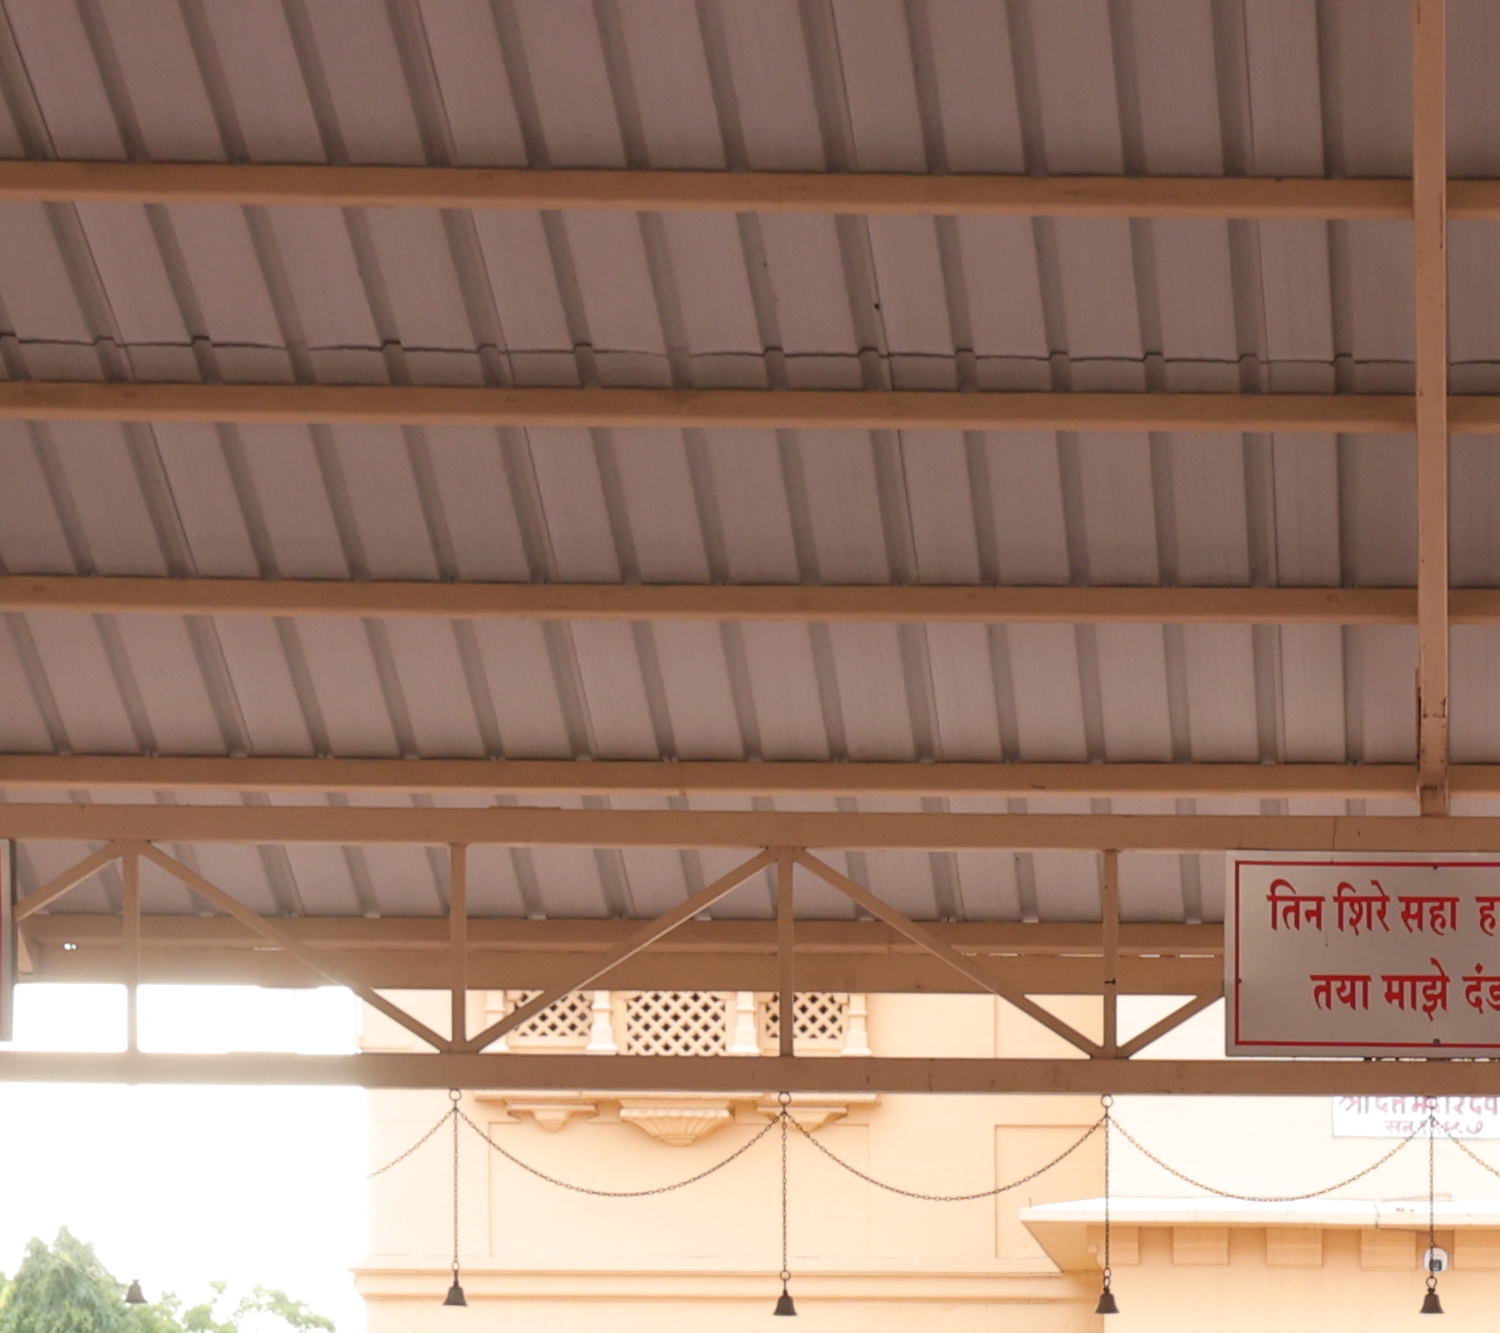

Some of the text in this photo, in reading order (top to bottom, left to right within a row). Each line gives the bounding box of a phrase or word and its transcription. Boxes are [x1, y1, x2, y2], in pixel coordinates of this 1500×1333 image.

[1267, 878, 1326, 929] तिन
[1333, 880, 1391, 933] शिरे
[1398, 896, 1460, 935] सहा
[1311, 974, 1372, 1009] तया
[1381, 958, 1451, 1021] माझे
